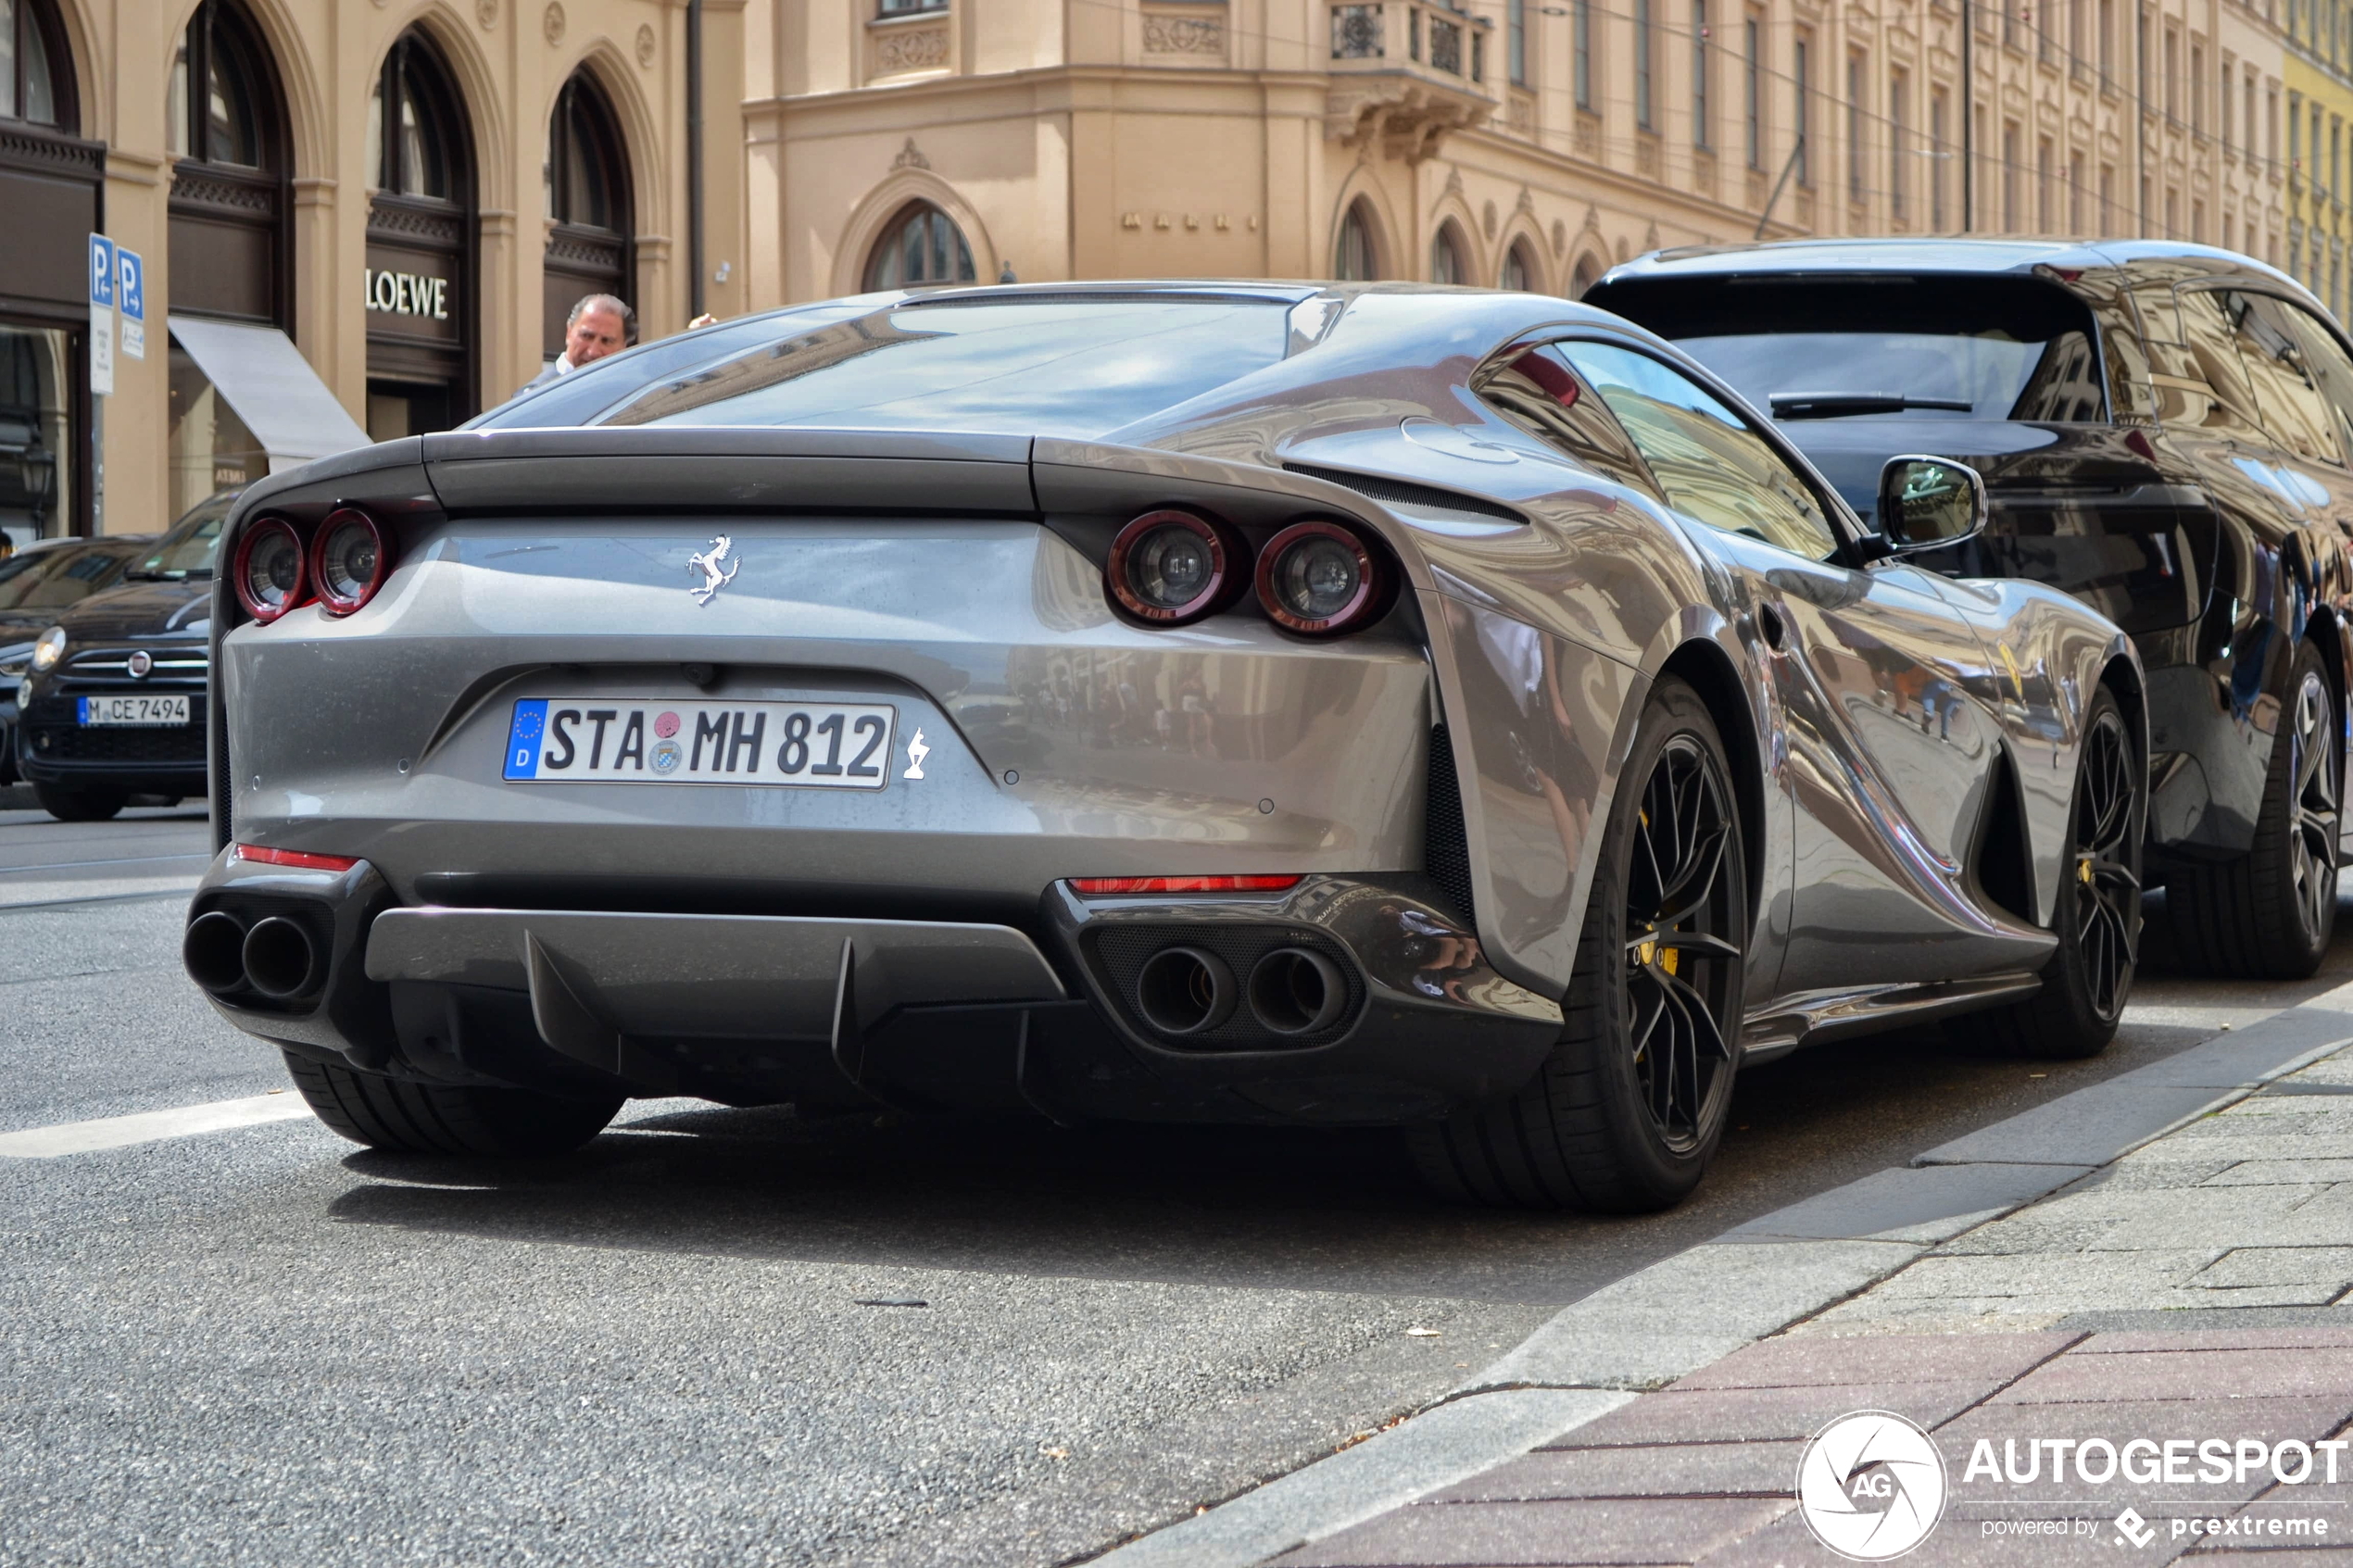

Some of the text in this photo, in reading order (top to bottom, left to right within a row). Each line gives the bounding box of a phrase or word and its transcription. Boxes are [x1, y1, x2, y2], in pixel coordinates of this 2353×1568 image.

[94, 244, 107, 296] P
[121, 257, 136, 307] P
[366, 269, 447, 320] LOEWE
[90, 700, 100, 720] M
[112, 699, 134, 720] CE
[139, 699, 185, 719] 7494
[515, 749, 530, 767] D
[544, 709, 644, 770] STA
[689, 710, 766, 772] MH
[777, 712, 886, 777] 812
